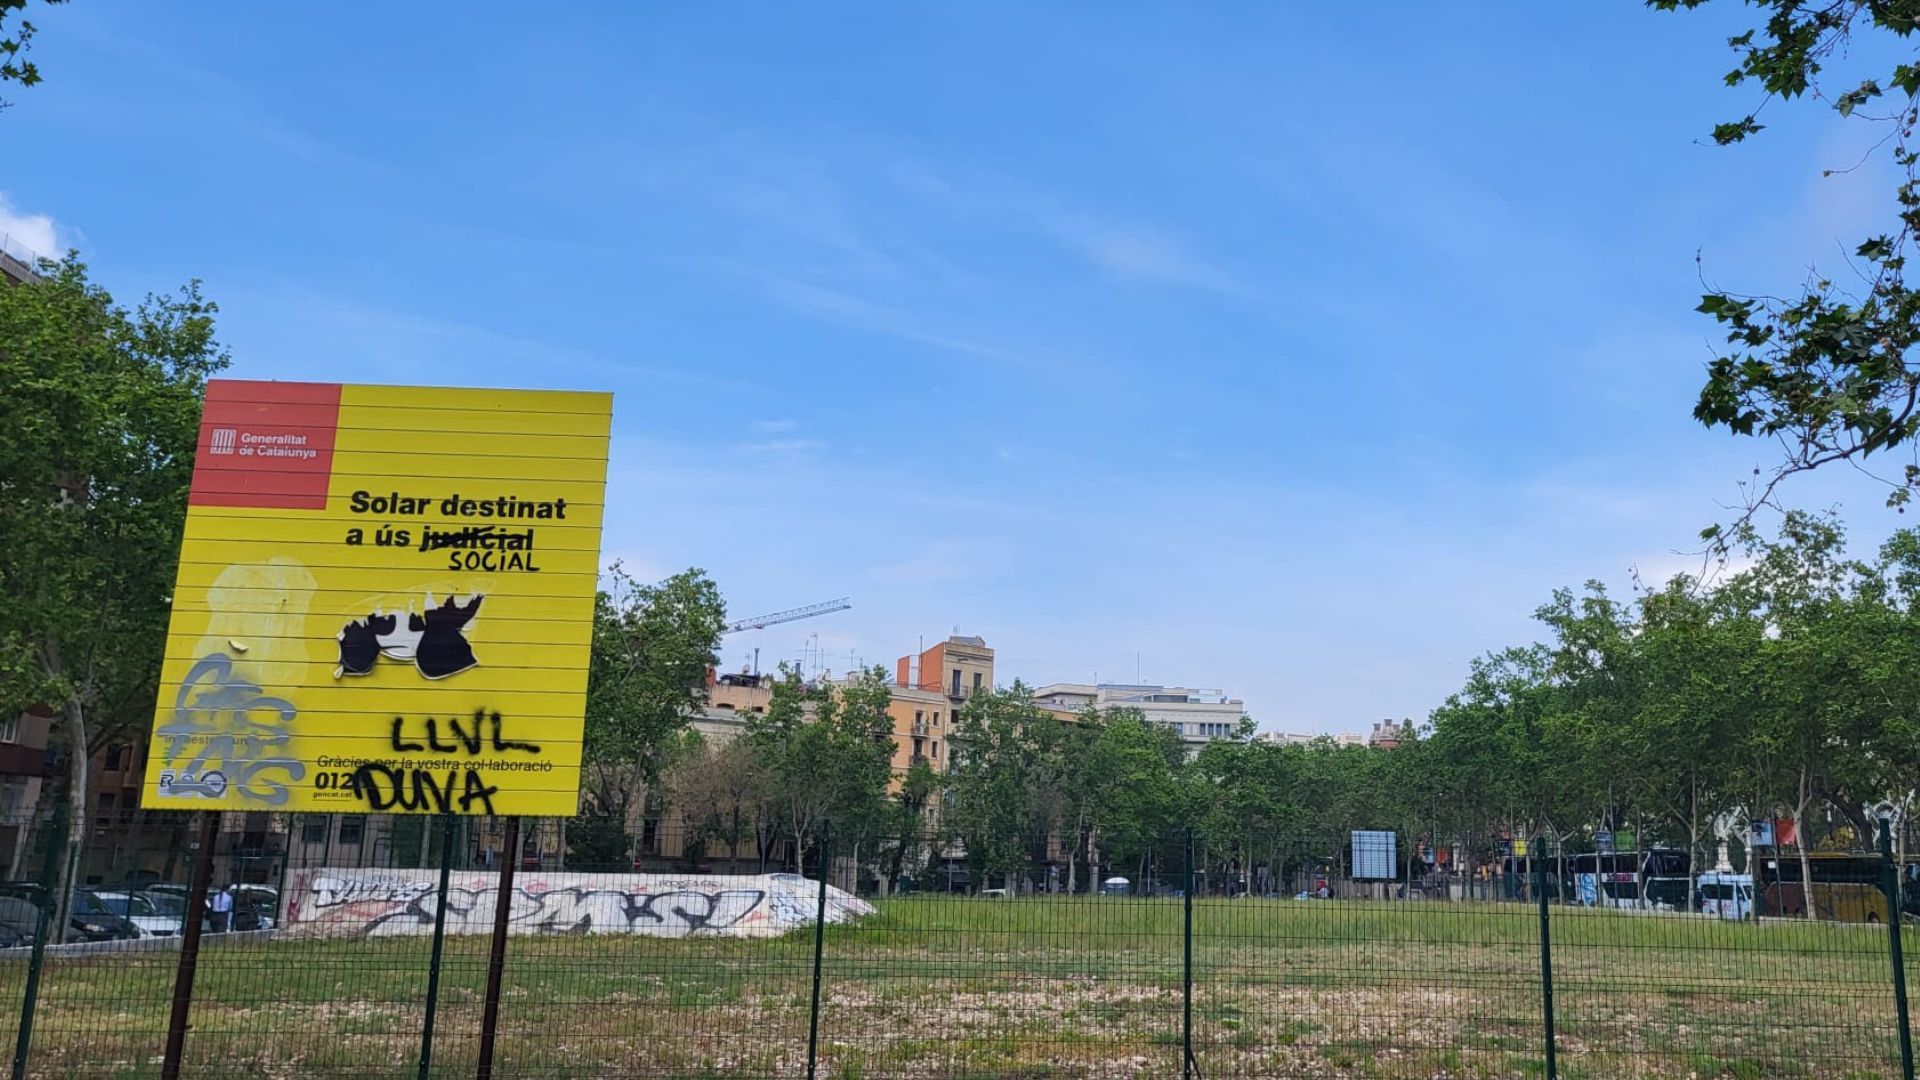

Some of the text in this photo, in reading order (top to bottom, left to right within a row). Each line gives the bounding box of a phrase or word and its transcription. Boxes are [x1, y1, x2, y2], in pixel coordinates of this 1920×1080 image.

[241, 433, 307, 445] Generalitat
[239, 446, 317, 460] de Catalunya
[350, 490, 567, 520] Solar destinat
[345, 528, 363, 546] a
[375, 524, 411, 547] ús
[317, 754, 369, 769] Gràcies
[401, 757, 413, 769] la
[417, 758, 460, 770] vostra
[314, 772, 354, 790] 012
